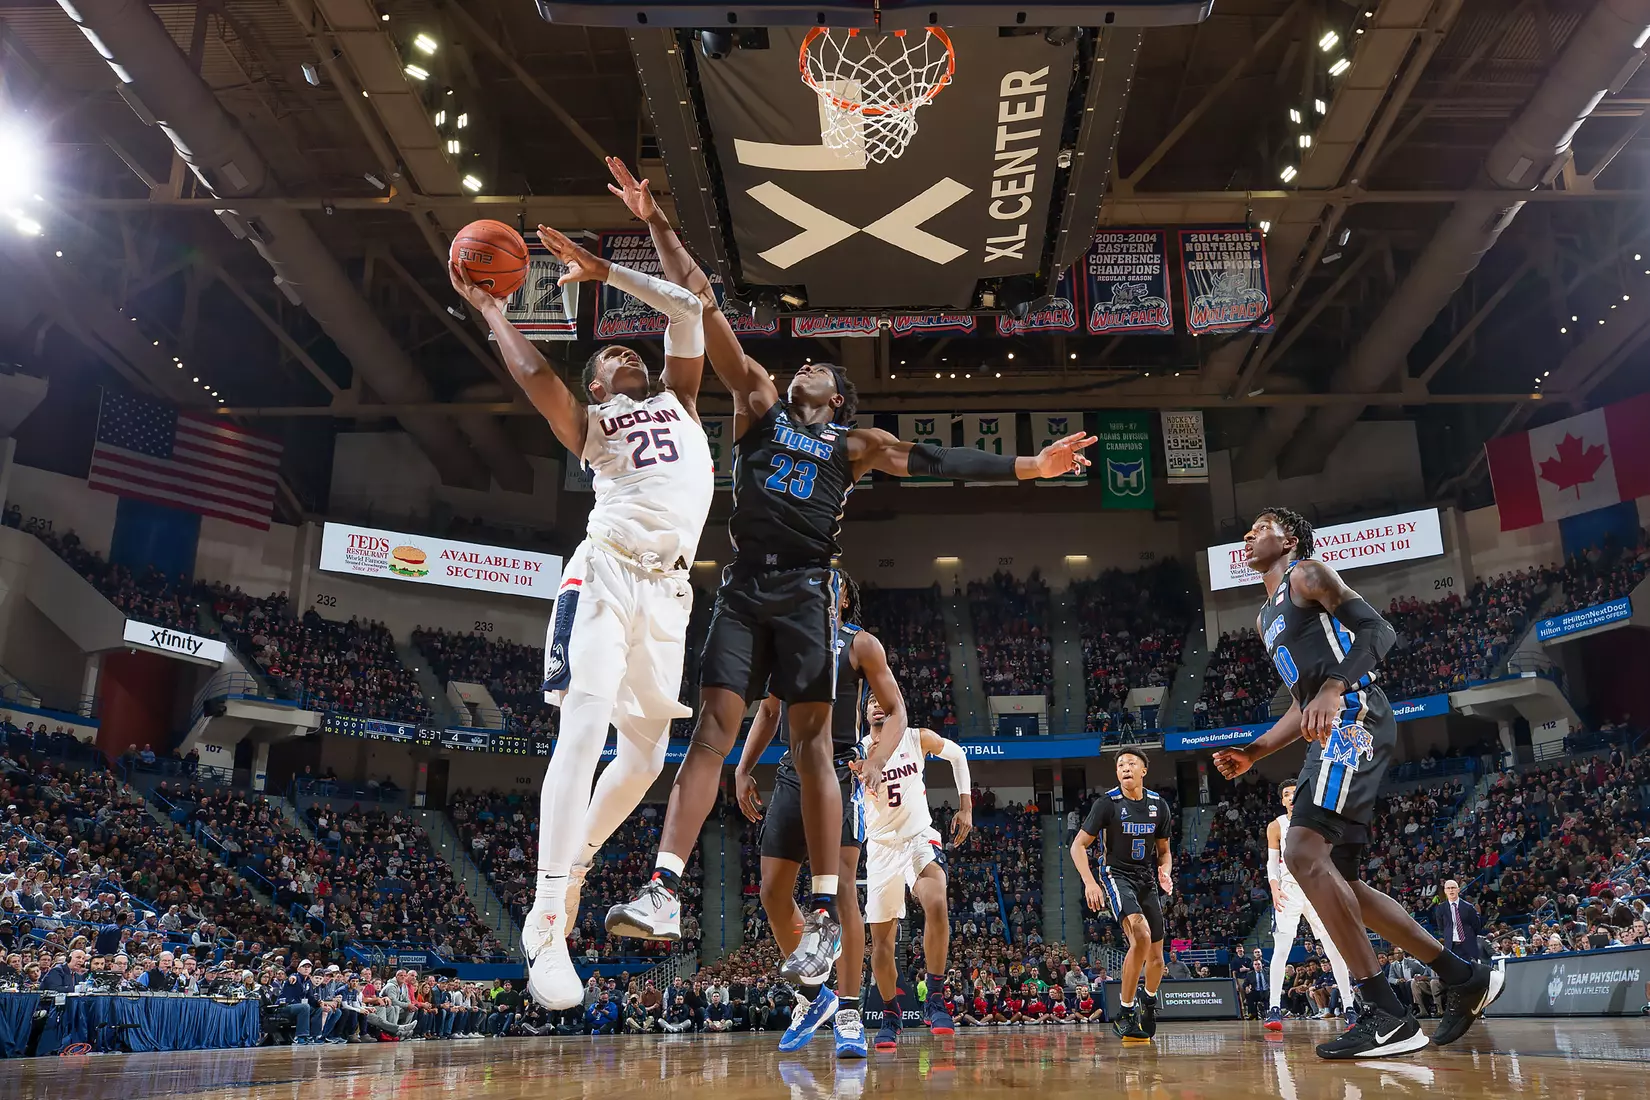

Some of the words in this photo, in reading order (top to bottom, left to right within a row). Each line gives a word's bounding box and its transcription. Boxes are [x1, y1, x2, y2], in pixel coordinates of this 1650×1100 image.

[989, 65, 1049, 220] CENTER
[606, 236, 655, 248] 1999-2
[984, 223, 1028, 263] XL
[1095, 234, 1157, 243] 2003-2004
[1190, 233, 1253, 242] 2014-2015
[1098, 243, 1153, 253] EASTERN
[1185, 241, 1259, 252] NORTHEAST
[610, 249, 660, 260] REGULA
[1089, 254, 1161, 264] CONFERENCE
[1195, 251, 1251, 261] DIVISION
[1089, 265, 1160, 275] CHAMPIONS
[1188, 260, 1261, 270] CHAMPIONS
[1035, 309, 1071, 325] PACK
[1093, 311, 1128, 327] WOLF
[1130, 307, 1166, 324] PACK
[1193, 305, 1227, 324] WOLF
[1230, 301, 1265, 320] PACK
[601, 316, 637, 334] WOLF
[600, 408, 681, 437] UCONN
[626, 427, 679, 469] 25
[771, 424, 834, 461] Tigers
[1106, 442, 1143, 450] CHAMPIONS
[1173, 457, 1183, 466] 18
[1192, 456, 1199, 466] 5
[764, 453, 818, 499] 23
[1313, 525, 1394, 549] AVAILABLE
[1397, 521, 1418, 535] BY
[348, 533, 389, 553] TED'S
[346, 547, 388, 559] RESTAURANT
[1228, 549, 1247, 563] TE
[1321, 542, 1386, 563] SECTION
[1390, 538, 1411, 552] 101
[440, 549, 520, 569] AVAILABLE
[524, 560, 543, 572] BY
[446, 565, 510, 583] SECTION
[514, 574, 533, 586] 101
[1433, 576, 1454, 590] 240
[316, 593, 337, 608] 232
[1562, 602, 1627, 625] #HiltonNextDoor
[1576, 619, 1593, 628] DEALS
[1593, 615, 1606, 624] AND
[1605, 609, 1628, 620] OFFERS
[474, 621, 494, 633] 233
[1540, 625, 1561, 637] Hilton
[150, 629, 203, 654] xfinity
[1405, 704, 1425, 714] Bank
[398, 726, 405, 735] 6
[1542, 720, 1557, 730] 112
[451, 733, 459, 742] 4
[1181, 735, 1210, 745] People's
[1209, 732, 1234, 742] United
[1233, 730, 1253, 739] Bank
[205, 744, 223, 754] 107
[962, 745, 1005, 755] OTBALL
[881, 762, 918, 783] CONN
[887, 783, 902, 807] 5
[1121, 822, 1156, 836] Tigers
[1131, 838, 1145, 860] 5
[1567, 972, 1589, 985] TEAM
[1589, 969, 1640, 984] PHYSICIANS
[1164, 991, 1211, 999] ORTHOPEDICS
[1564, 988, 1582, 996] UCONN
[1582, 986, 1610, 995] ATHLETICS
[864, 1010, 920, 1020] TRAERS
